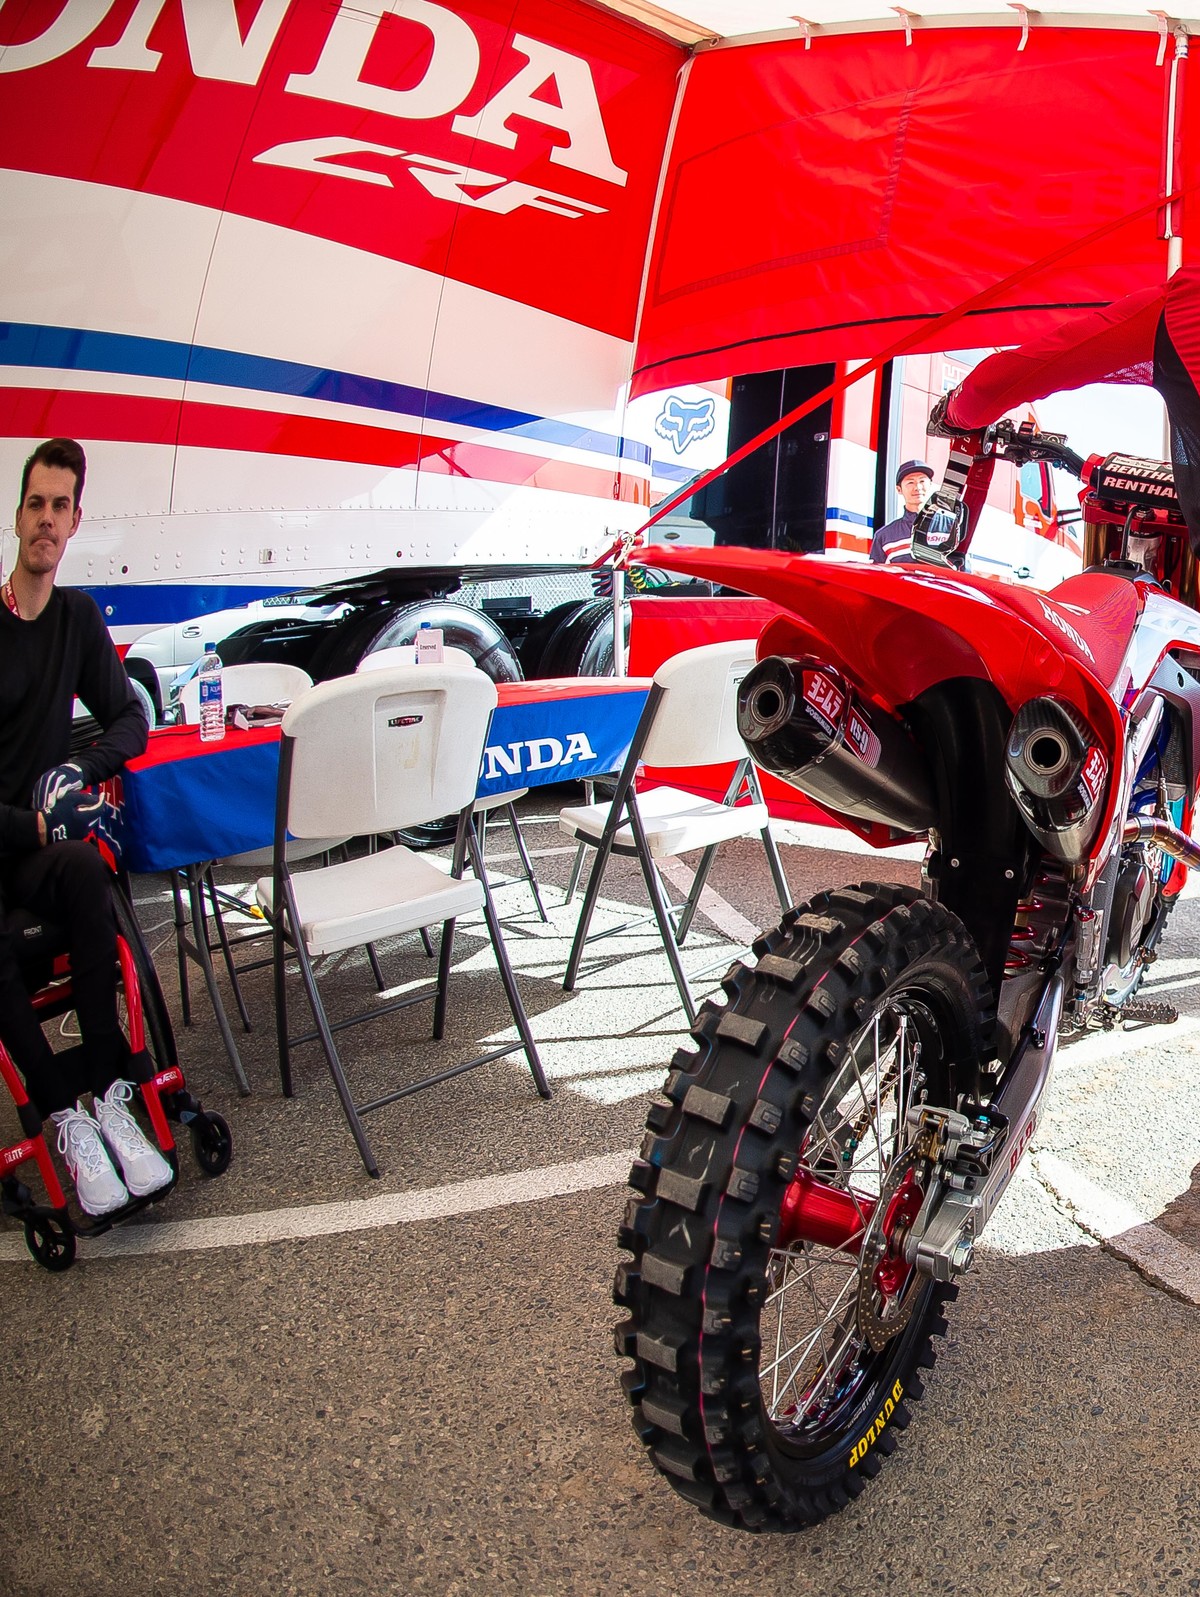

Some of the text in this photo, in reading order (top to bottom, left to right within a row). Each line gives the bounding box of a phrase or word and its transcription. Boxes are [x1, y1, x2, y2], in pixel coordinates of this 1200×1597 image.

[252, 136, 609, 218] CRF
[1105, 463, 1175, 483] RENTHA
[1037, 598, 1096, 664] HONDA
[479, 732, 598, 779] NDA
[850, 1378, 904, 1468] DUNLOP
